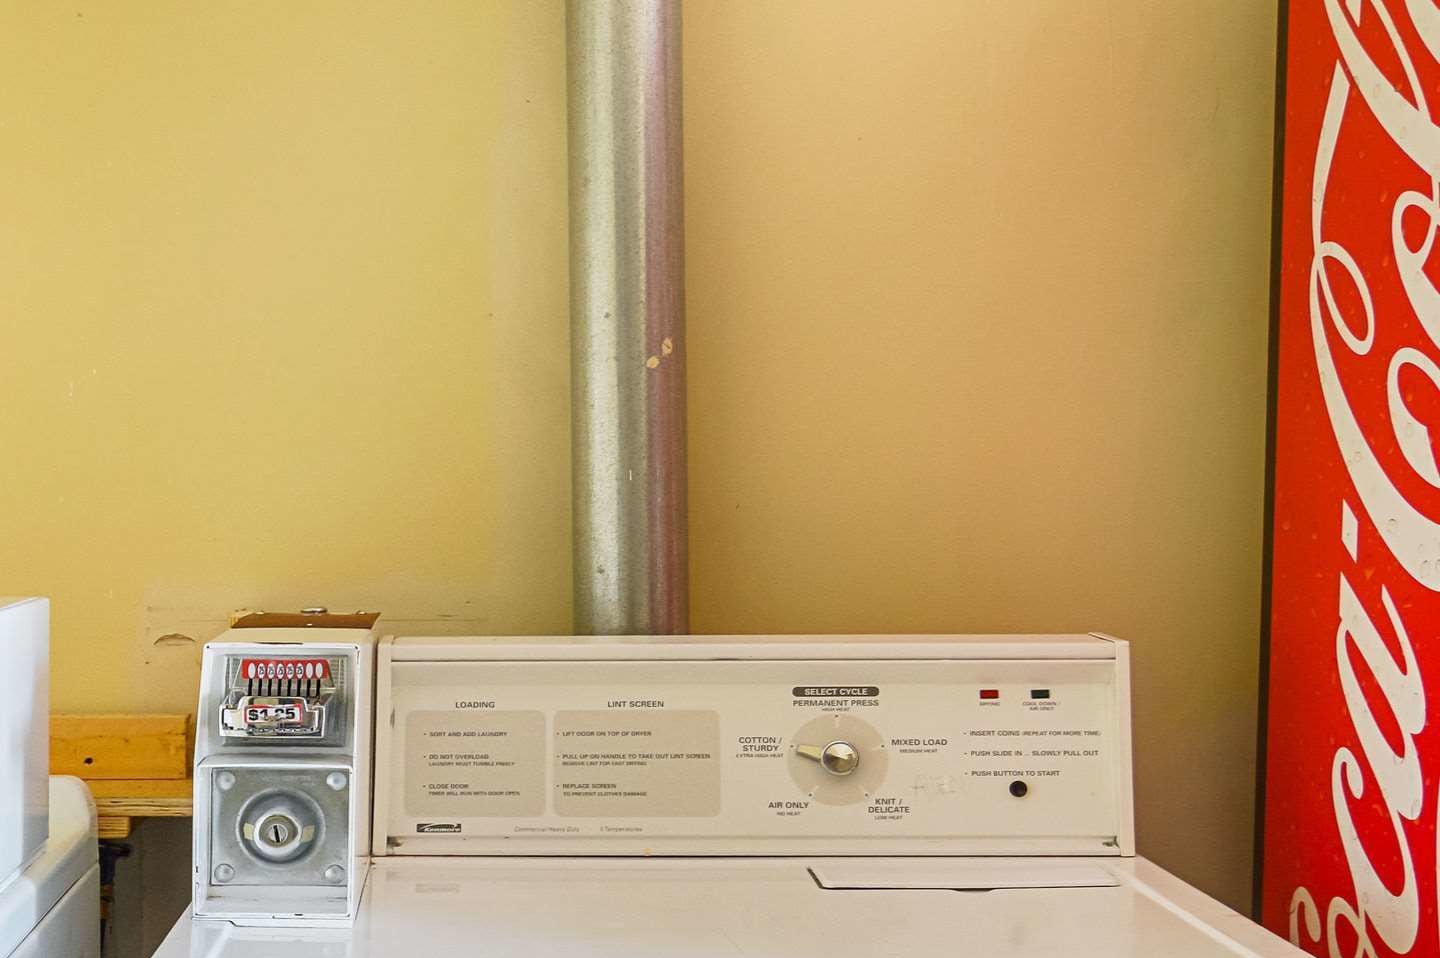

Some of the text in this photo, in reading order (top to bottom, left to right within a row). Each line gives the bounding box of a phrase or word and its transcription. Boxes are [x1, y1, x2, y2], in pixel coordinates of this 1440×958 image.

[804, 688, 868, 696] SELECT CYCLE
[455, 701, 495, 709] LOADING
[607, 700, 665, 708] LINT SCREEN
[792, 699, 880, 707] PERMANENT PRESS
[738, 736, 777, 744] COTTON
[891, 738, 948, 746] MIXED LOAD
[742, 744, 780, 752] STURDY
[768, 801, 809, 809] AIR ONLY
[867, 806, 910, 814] DELICATE
